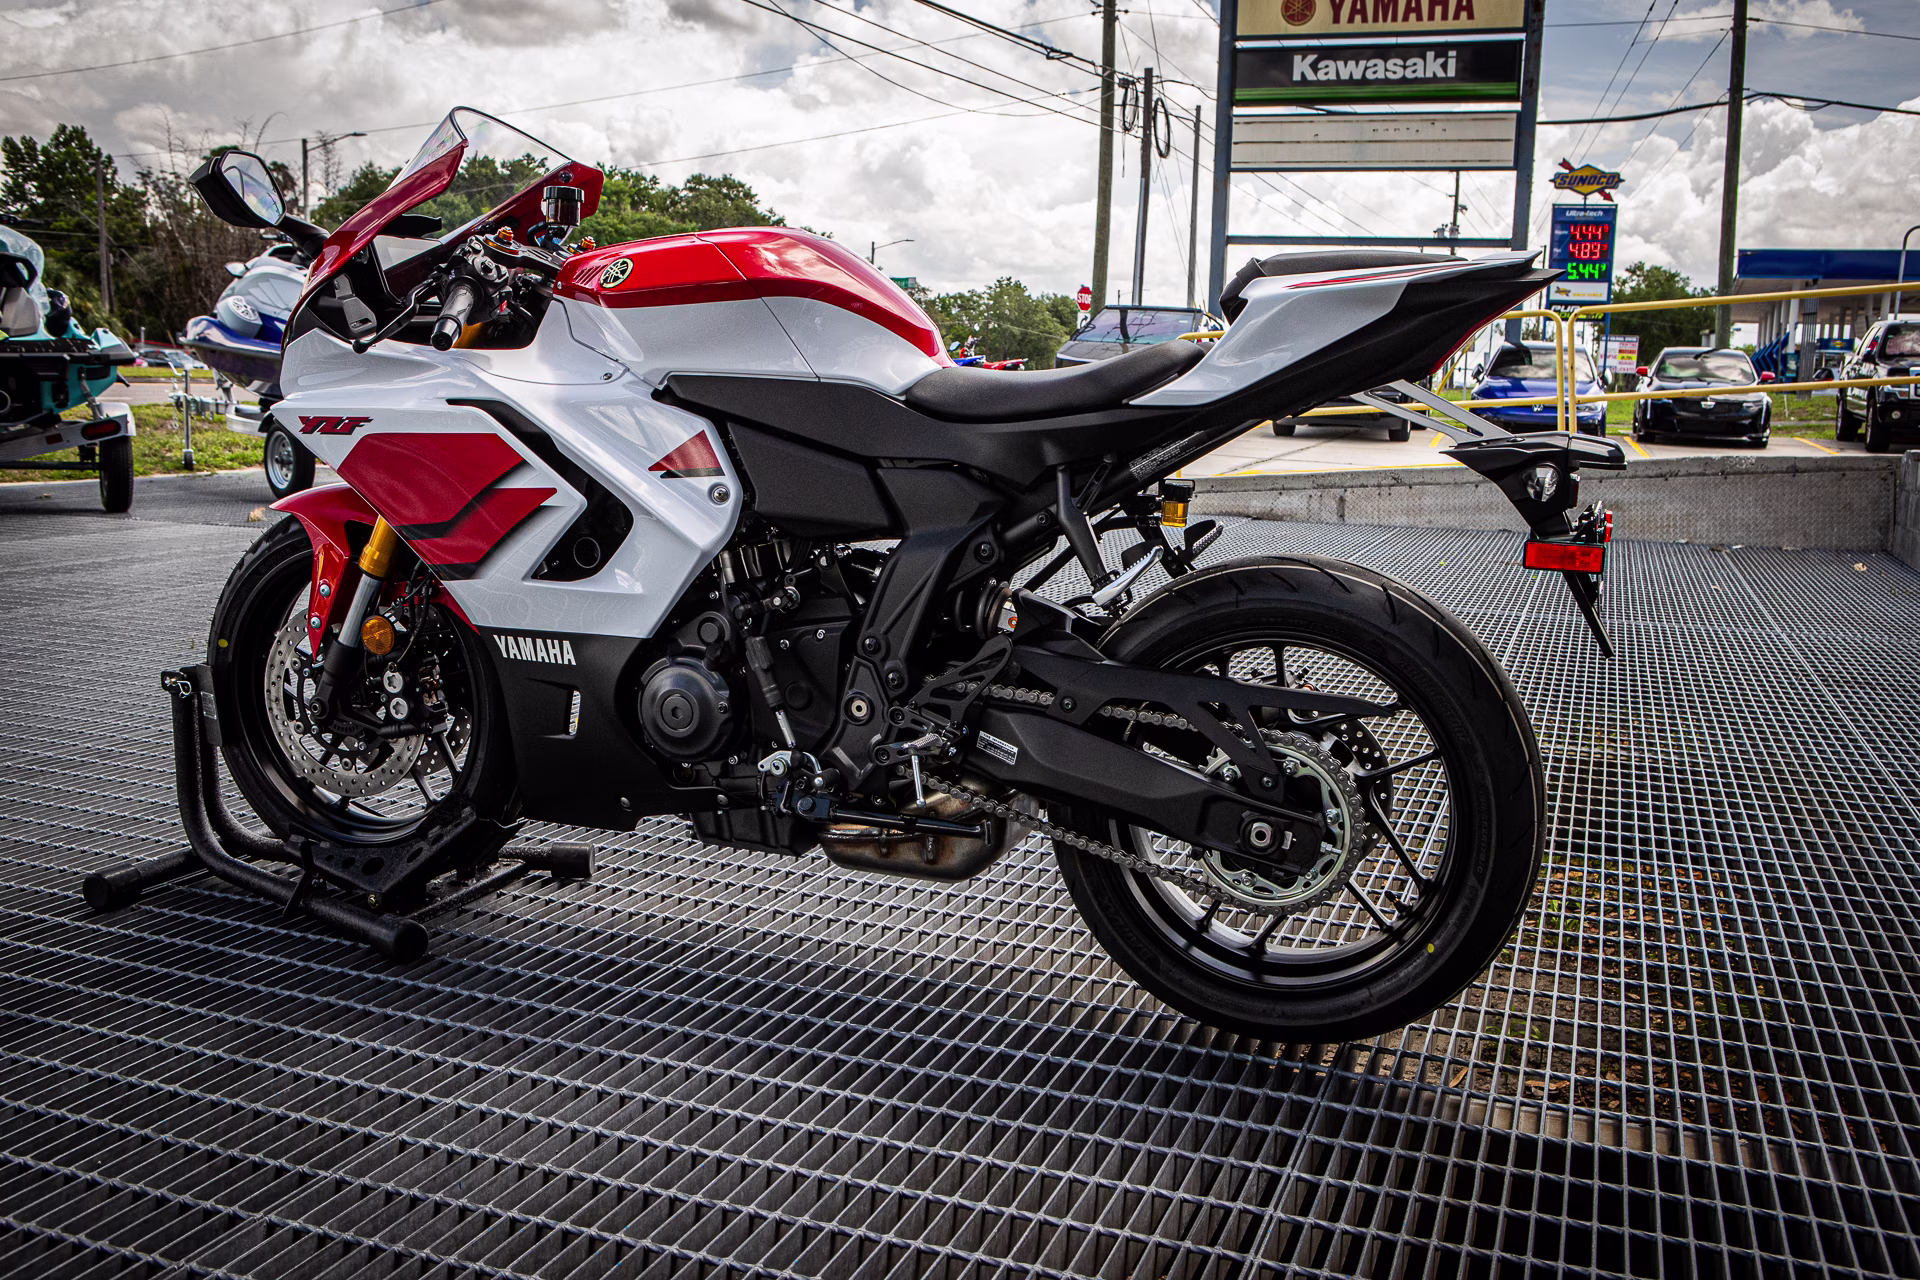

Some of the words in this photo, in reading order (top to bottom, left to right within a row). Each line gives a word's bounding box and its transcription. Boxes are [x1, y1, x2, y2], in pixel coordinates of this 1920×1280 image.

[1330, 0, 1475, 25] YAMAHA
[1292, 50, 1457, 82] Kawasaki
[1559, 173, 1617, 187] SUNOCO
[493, 634, 577, 666] YAMAHA
